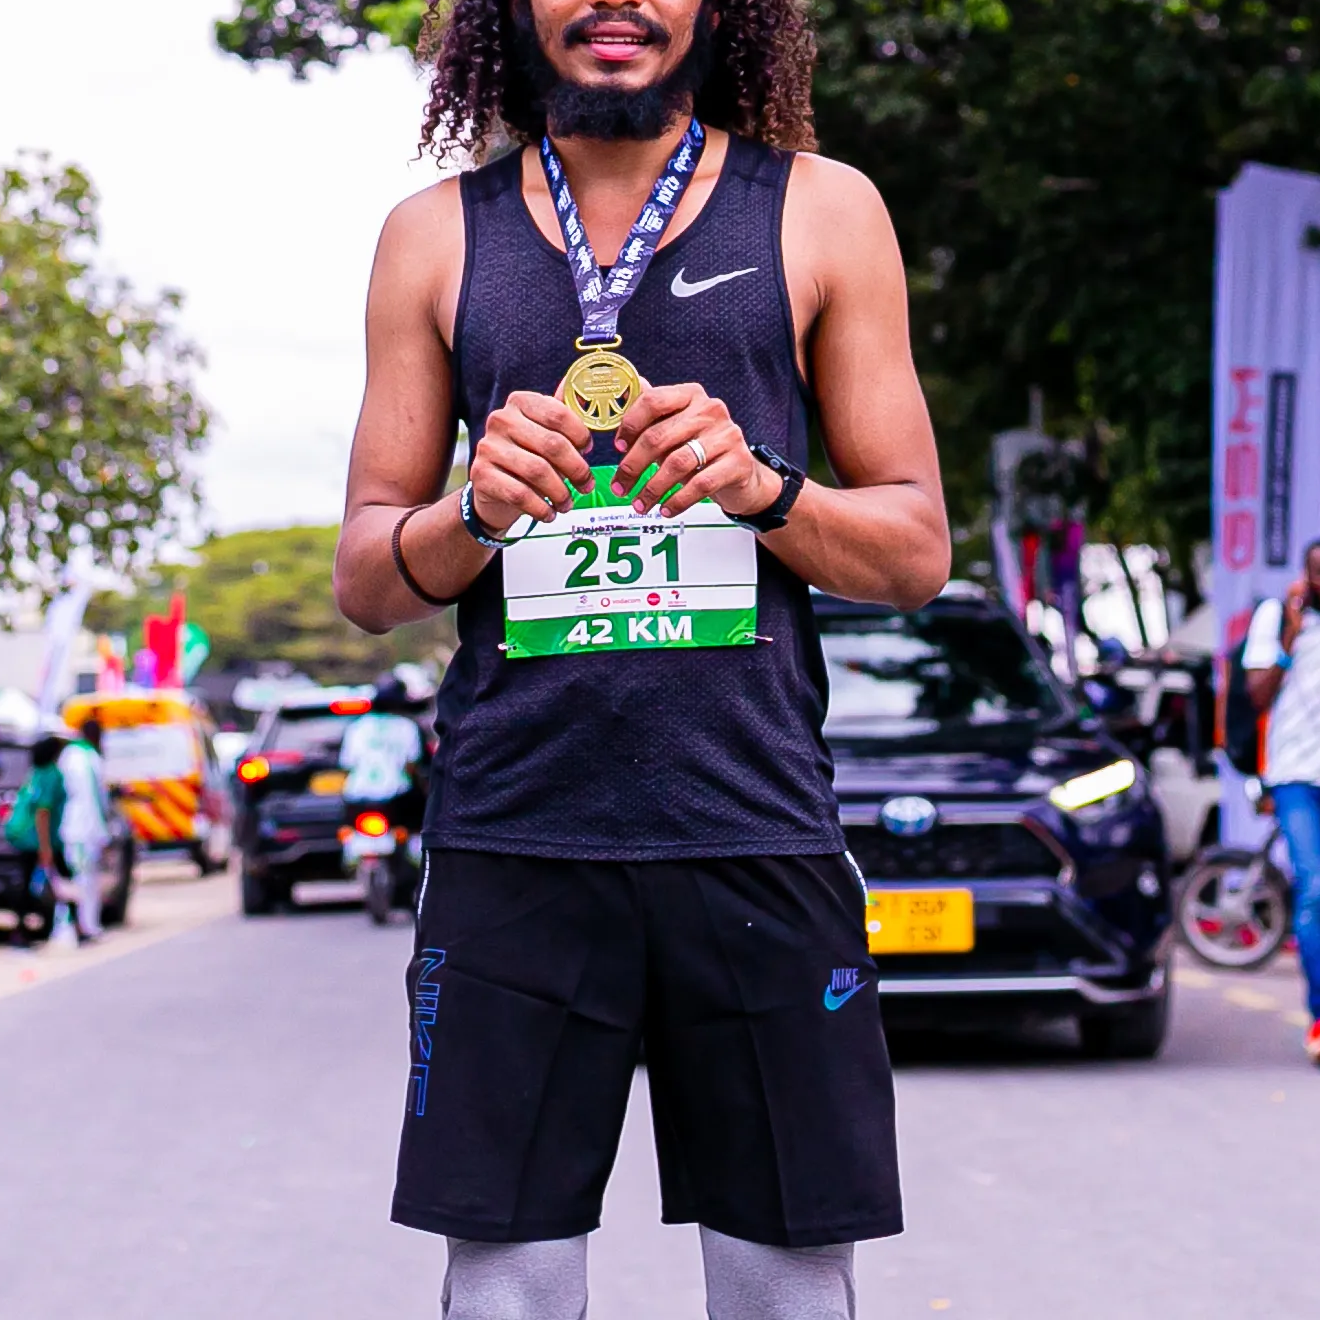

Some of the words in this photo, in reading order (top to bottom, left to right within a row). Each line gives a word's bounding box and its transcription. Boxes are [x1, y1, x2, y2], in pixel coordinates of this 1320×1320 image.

[564, 534, 681, 588] 251
[612, 597, 641, 605] vodacom
[567, 618, 614, 646] 42
[628, 615, 693, 643] KM
[832, 967, 859, 991] NIKE
